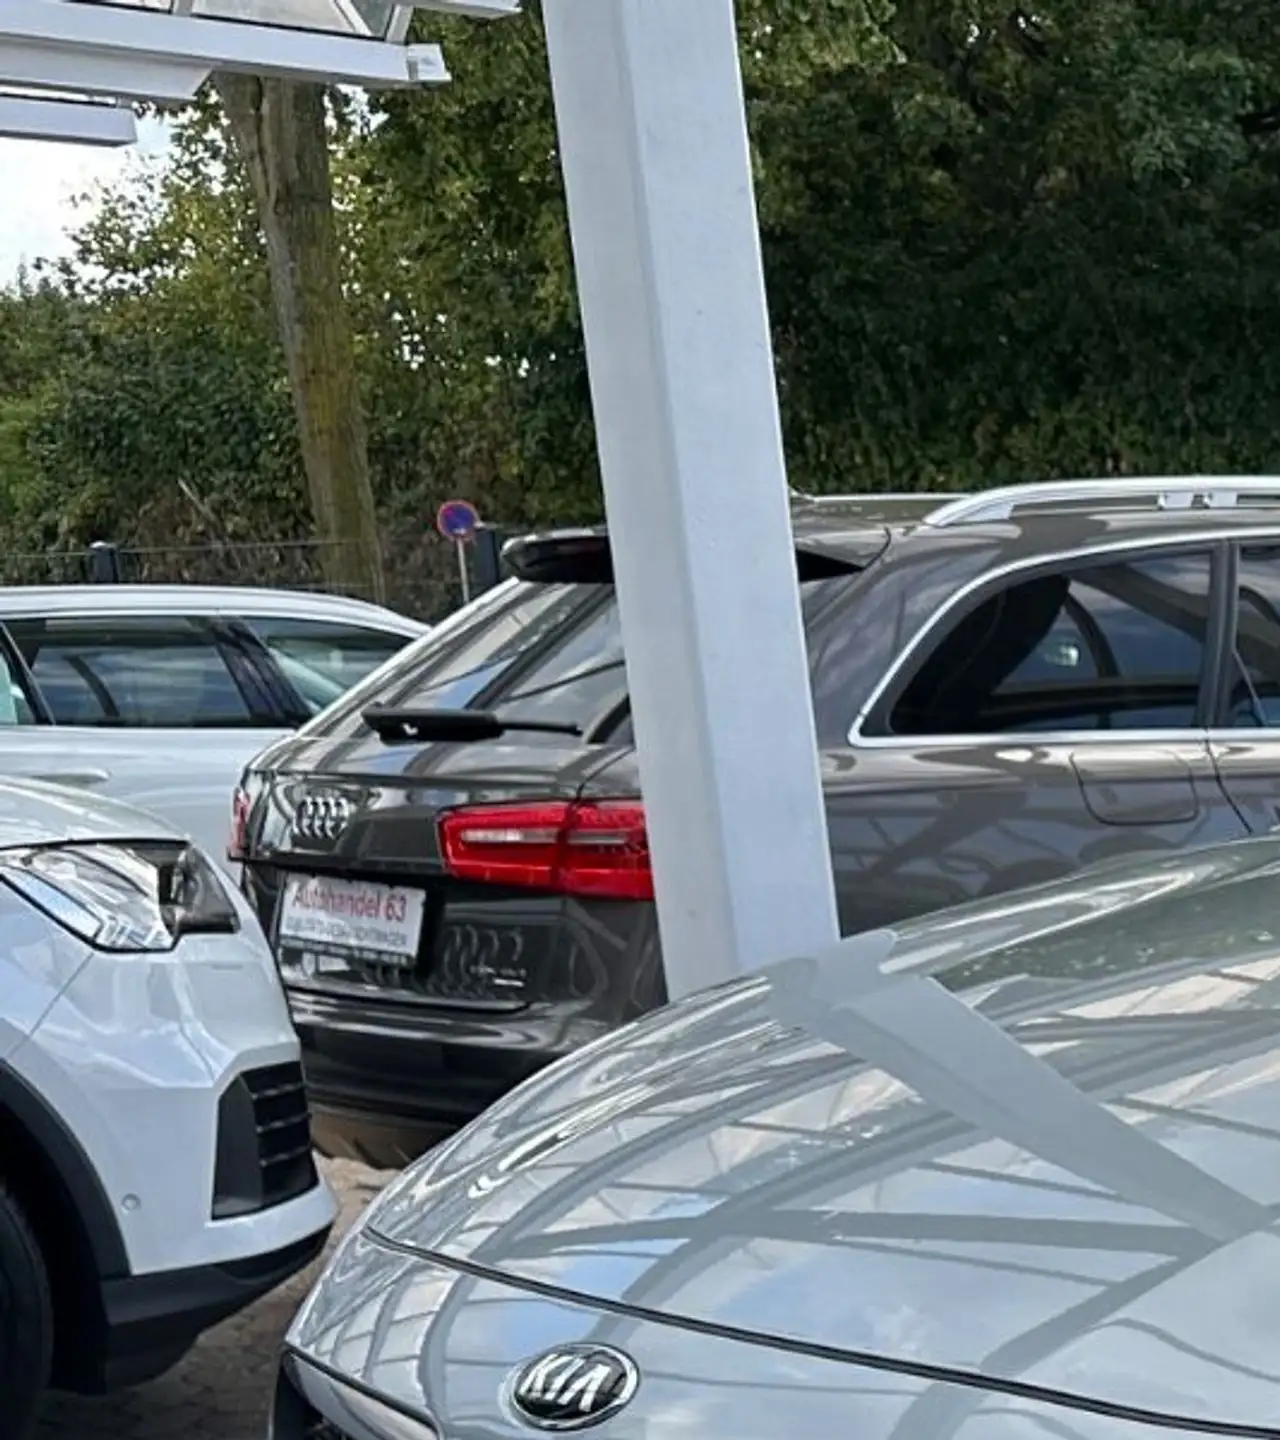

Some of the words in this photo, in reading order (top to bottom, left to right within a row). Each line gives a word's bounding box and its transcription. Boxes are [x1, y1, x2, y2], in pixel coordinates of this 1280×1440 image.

[293, 883, 381, 918] Autohandel
[386, 893, 407, 922] 63
[519, 1353, 612, 1413] KIA
